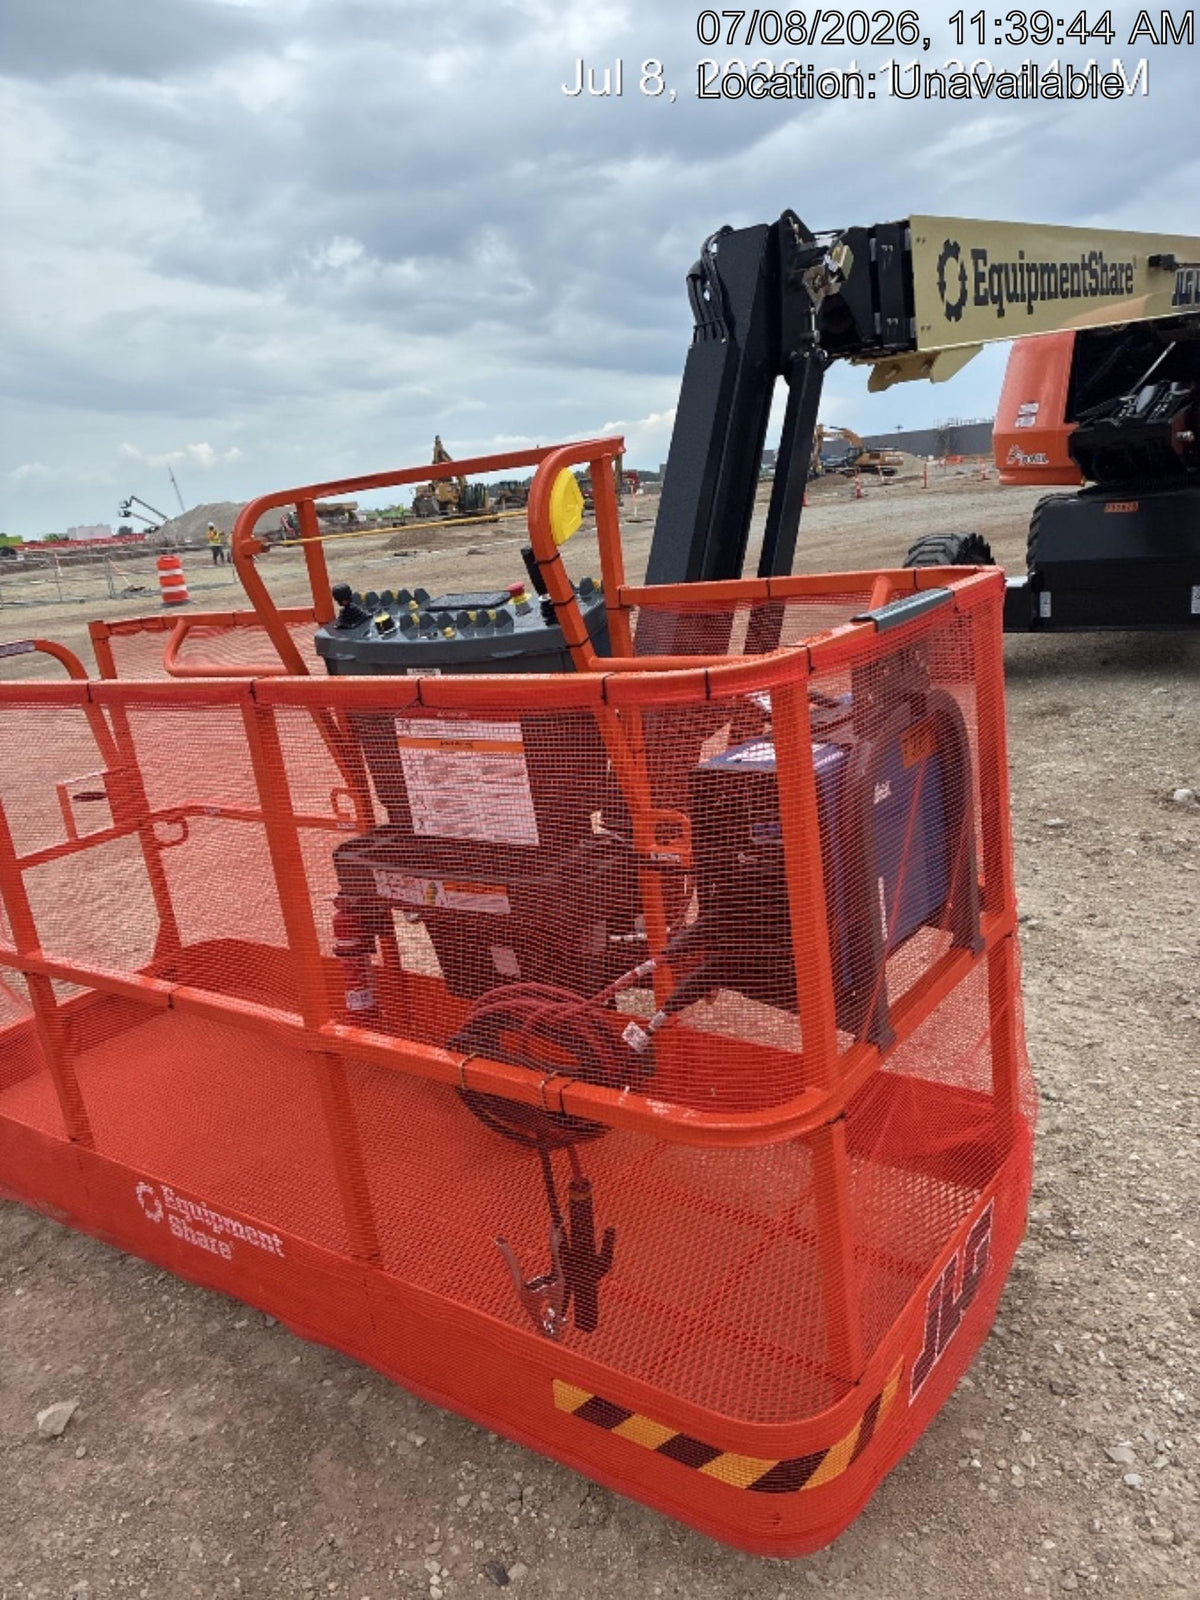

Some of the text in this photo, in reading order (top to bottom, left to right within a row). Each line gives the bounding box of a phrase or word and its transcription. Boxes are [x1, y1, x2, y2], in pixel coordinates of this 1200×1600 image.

[971, 248, 1134, 318] EquipmentShare
[161, 1184, 285, 1258] Equipment
[168, 1214, 232, 1260] Share
